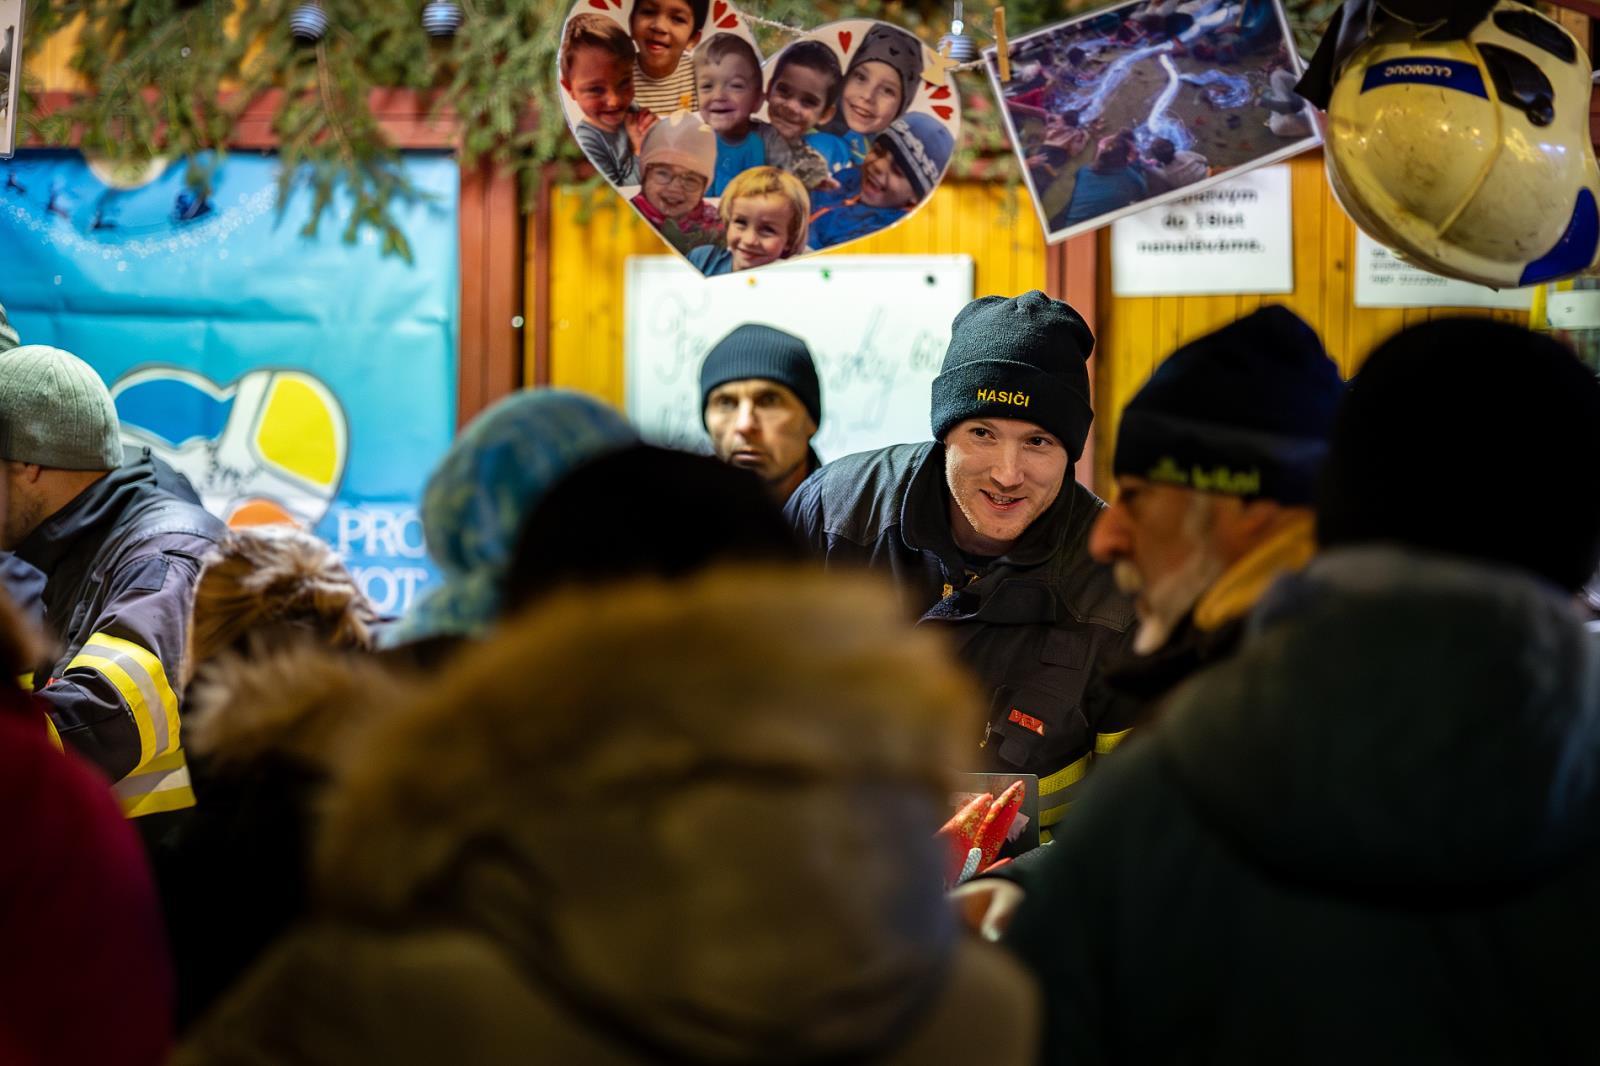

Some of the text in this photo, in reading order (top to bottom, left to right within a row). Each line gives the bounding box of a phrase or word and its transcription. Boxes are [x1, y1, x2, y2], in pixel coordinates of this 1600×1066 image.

[977, 388, 1030, 408] HASIČI
[339, 508, 427, 558] PRO
[352, 566, 429, 616] OT
